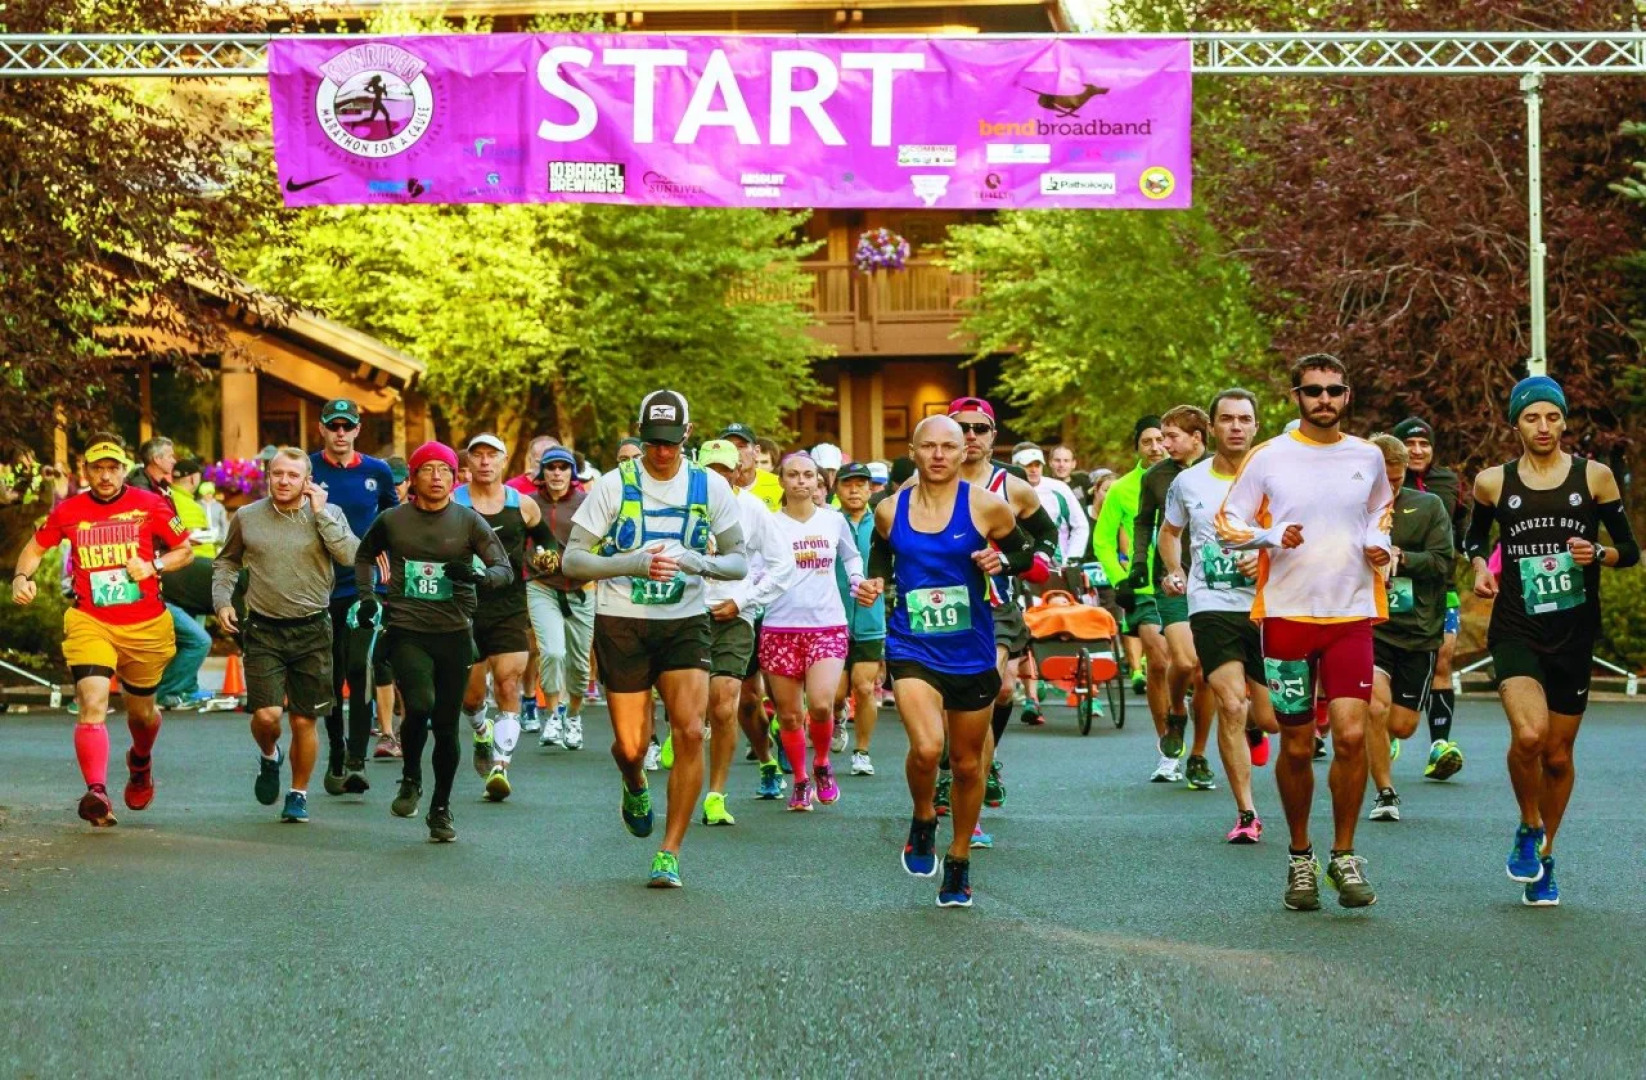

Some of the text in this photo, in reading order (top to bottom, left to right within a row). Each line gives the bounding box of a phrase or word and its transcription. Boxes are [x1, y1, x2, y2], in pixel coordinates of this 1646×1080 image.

[326, 44, 420, 83] SUNRIVER
[537, 45, 925, 147] START
[321, 109, 370, 154] MARATHON
[375, 141, 397, 154] FOR
[400, 138, 408, 146] A
[408, 107, 430, 137] CAUSE
[979, 118, 1152, 137] bendbroadband
[1060, 181, 1113, 190] Pathology
[1510, 517, 1587, 537] JACUZZI BOYS
[78, 541, 140, 569] AGENT
[1507, 543, 1561, 555] ATHLETIC
[107, 584, 126, 603] 72
[418, 579, 438, 595] 85
[643, 581, 676, 599] 117
[1536, 573, 1572, 595] 116
[922, 607, 958, 627] 119
[1284, 677, 1305, 698] 21
